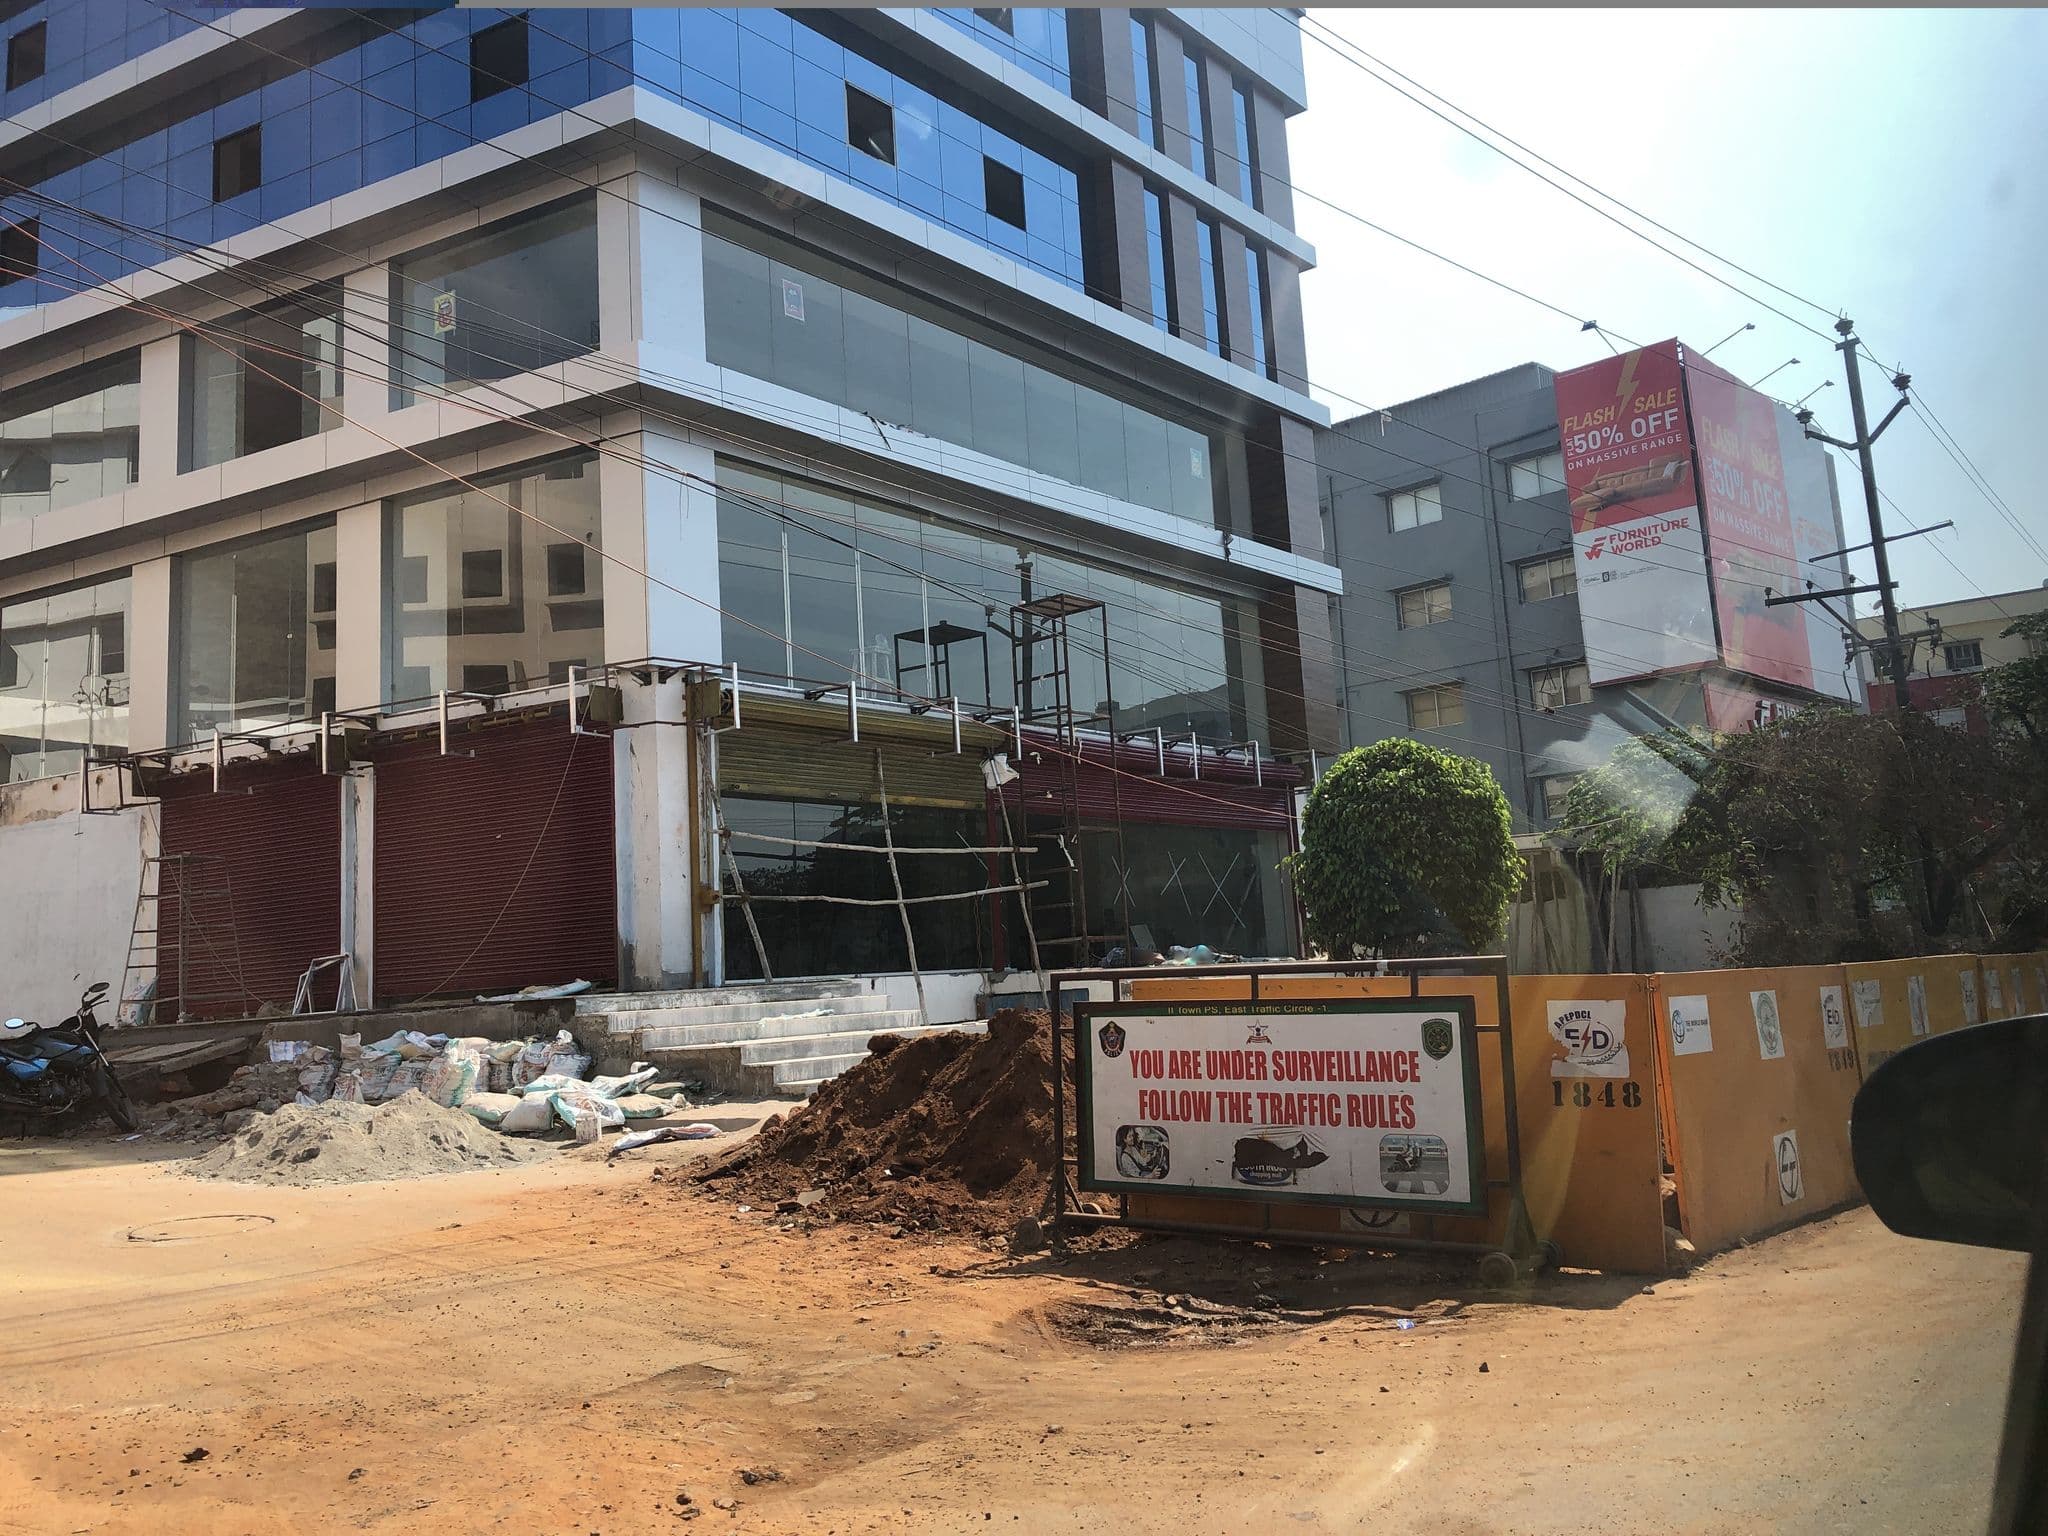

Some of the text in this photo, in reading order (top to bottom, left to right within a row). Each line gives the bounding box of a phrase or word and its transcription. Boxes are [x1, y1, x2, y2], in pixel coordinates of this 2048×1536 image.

[1563, 387, 1678, 434] FLASH SALE
[1573, 407, 1679, 454] 50% OFF
[1567, 433, 1683, 471] ON MASSIVE RANGE
[1609, 516, 1690, 545] FURNITURE
[1611, 535, 1662, 555] WORLD
[1224, 1005, 1247, 1014] East
[1251, 1004, 1281, 1014] Traffic
[1283, 1004, 1314, 1013] Circle
[1129, 1050, 1421, 1083] YOU ARE UNDER SURVEILLANCE
[1138, 1089, 1417, 1129] FOLLOW THE TRAFFIC RULES
[1552, 1081, 1642, 1108] 1848
